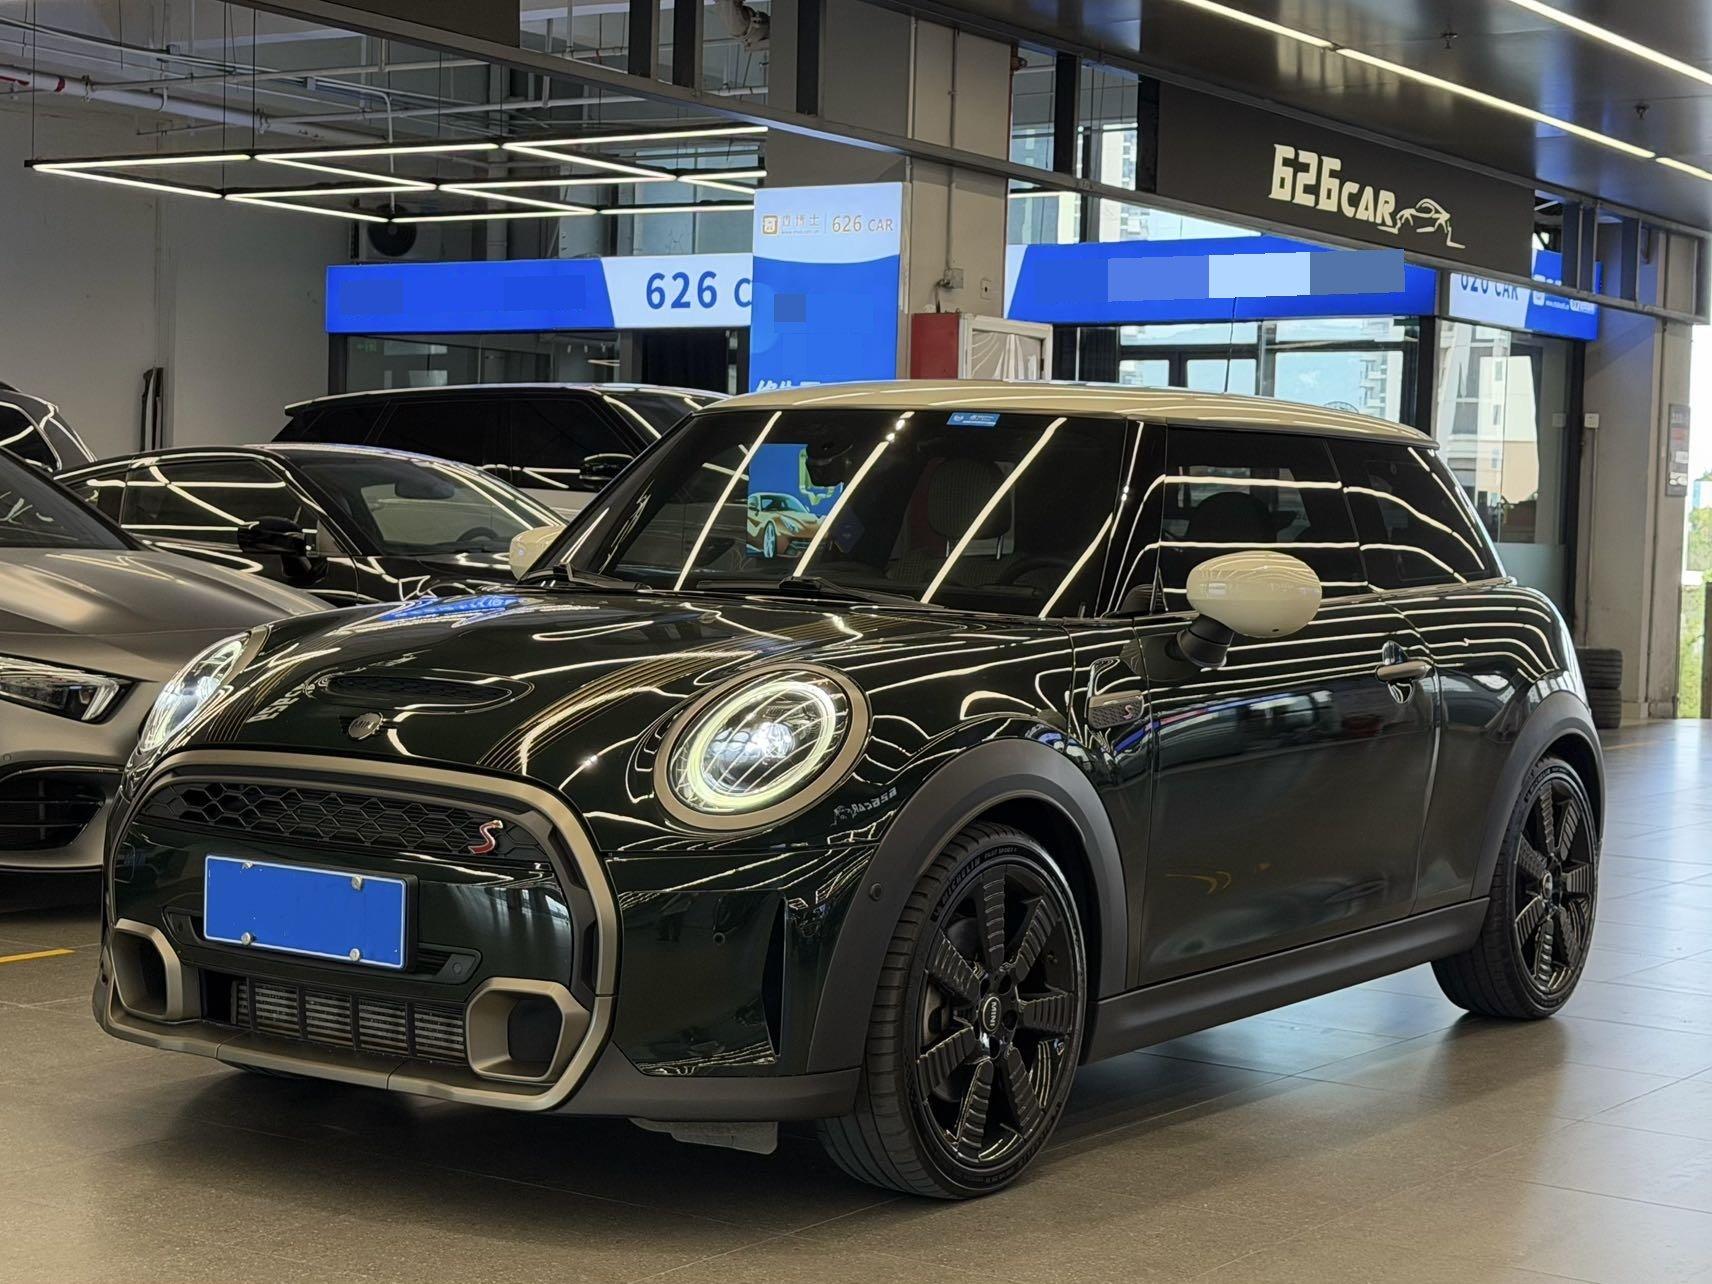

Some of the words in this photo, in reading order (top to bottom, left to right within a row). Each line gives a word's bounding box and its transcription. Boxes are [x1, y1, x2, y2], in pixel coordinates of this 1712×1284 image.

[832, 214, 863, 233] 626
[867, 218, 893, 232] CAR
[646, 270, 717, 310] 626
[468, 819, 504, 855] S
[989, 1001, 998, 1027] MINI
